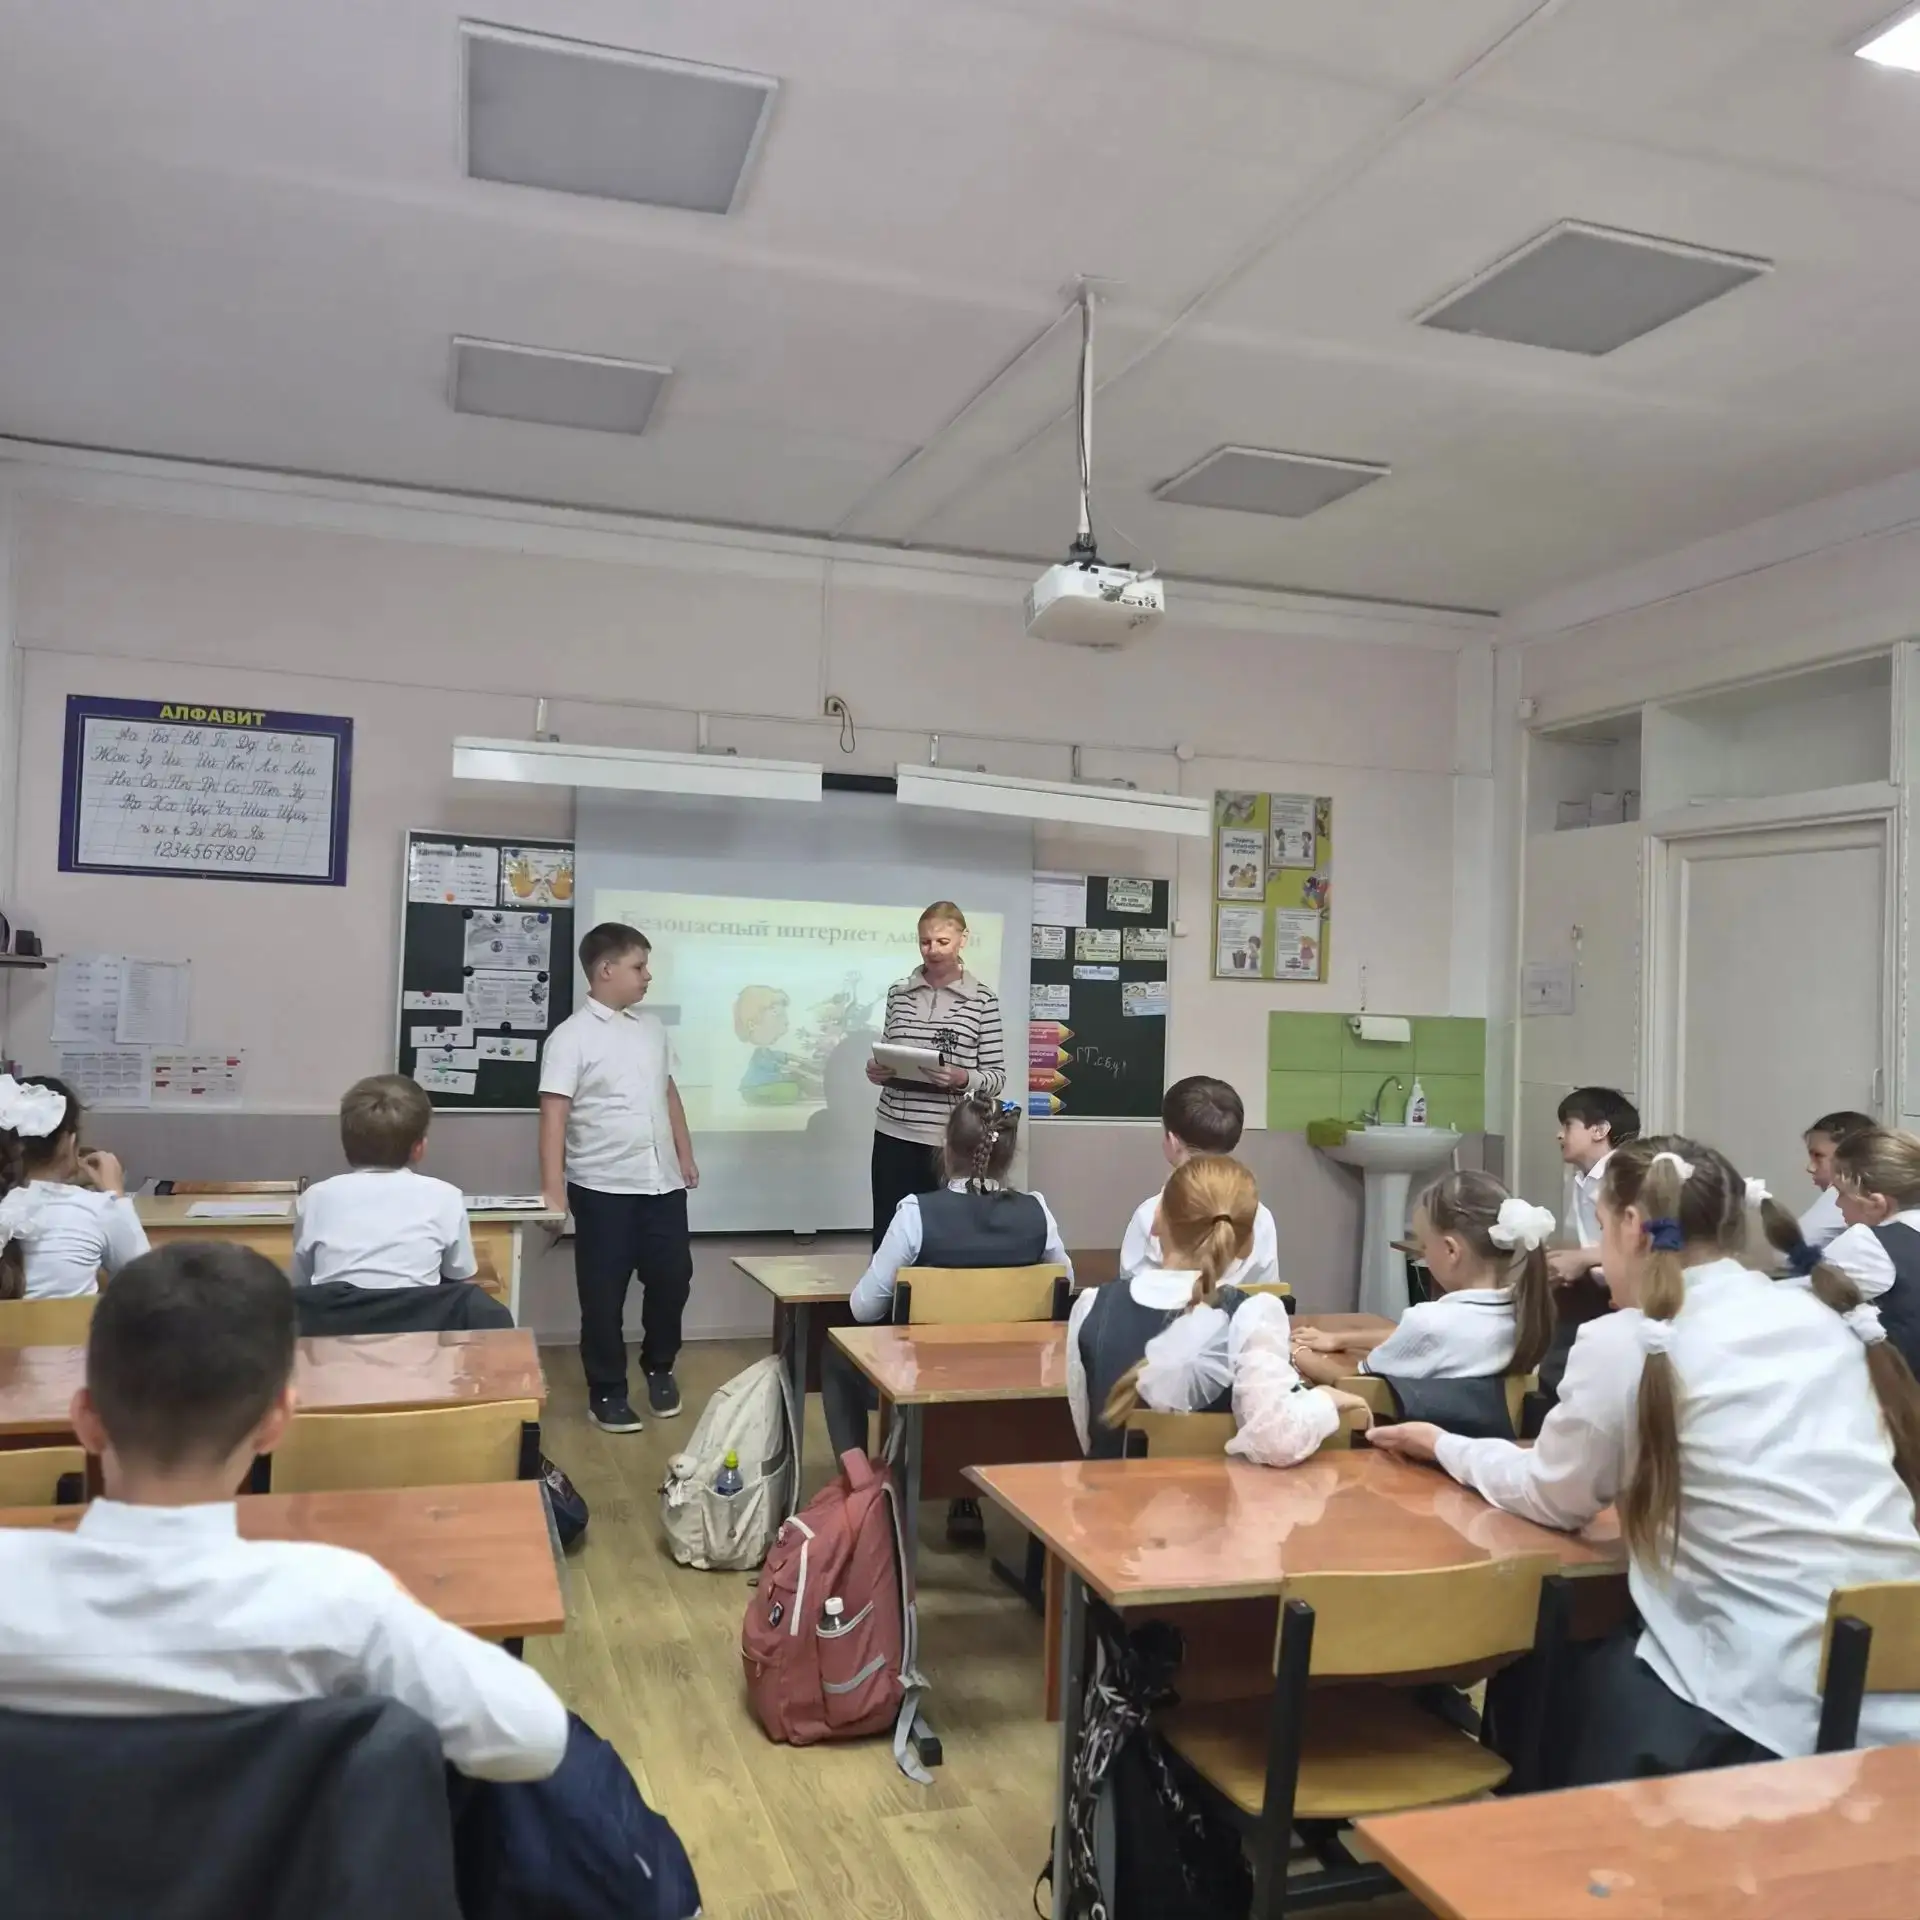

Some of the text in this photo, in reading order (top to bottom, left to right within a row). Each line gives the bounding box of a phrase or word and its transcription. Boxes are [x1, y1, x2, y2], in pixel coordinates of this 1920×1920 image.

[160, 704, 266, 726] АЛФАВИТ
[150, 727, 170, 743] Бб
[181, 730, 201, 746] Вв
[236, 735, 256, 755] Дд
[91, 745, 130, 762] Жж
[137, 748, 152, 770] Зз
[227, 755, 244, 770] Кк
[140, 772, 158, 788] Оо
[224, 778, 240, 793] Сс
[154, 841, 256, 862] 1234567890
[619, 910, 770, 938] Безопасный
[776, 922, 879, 946] интернет
